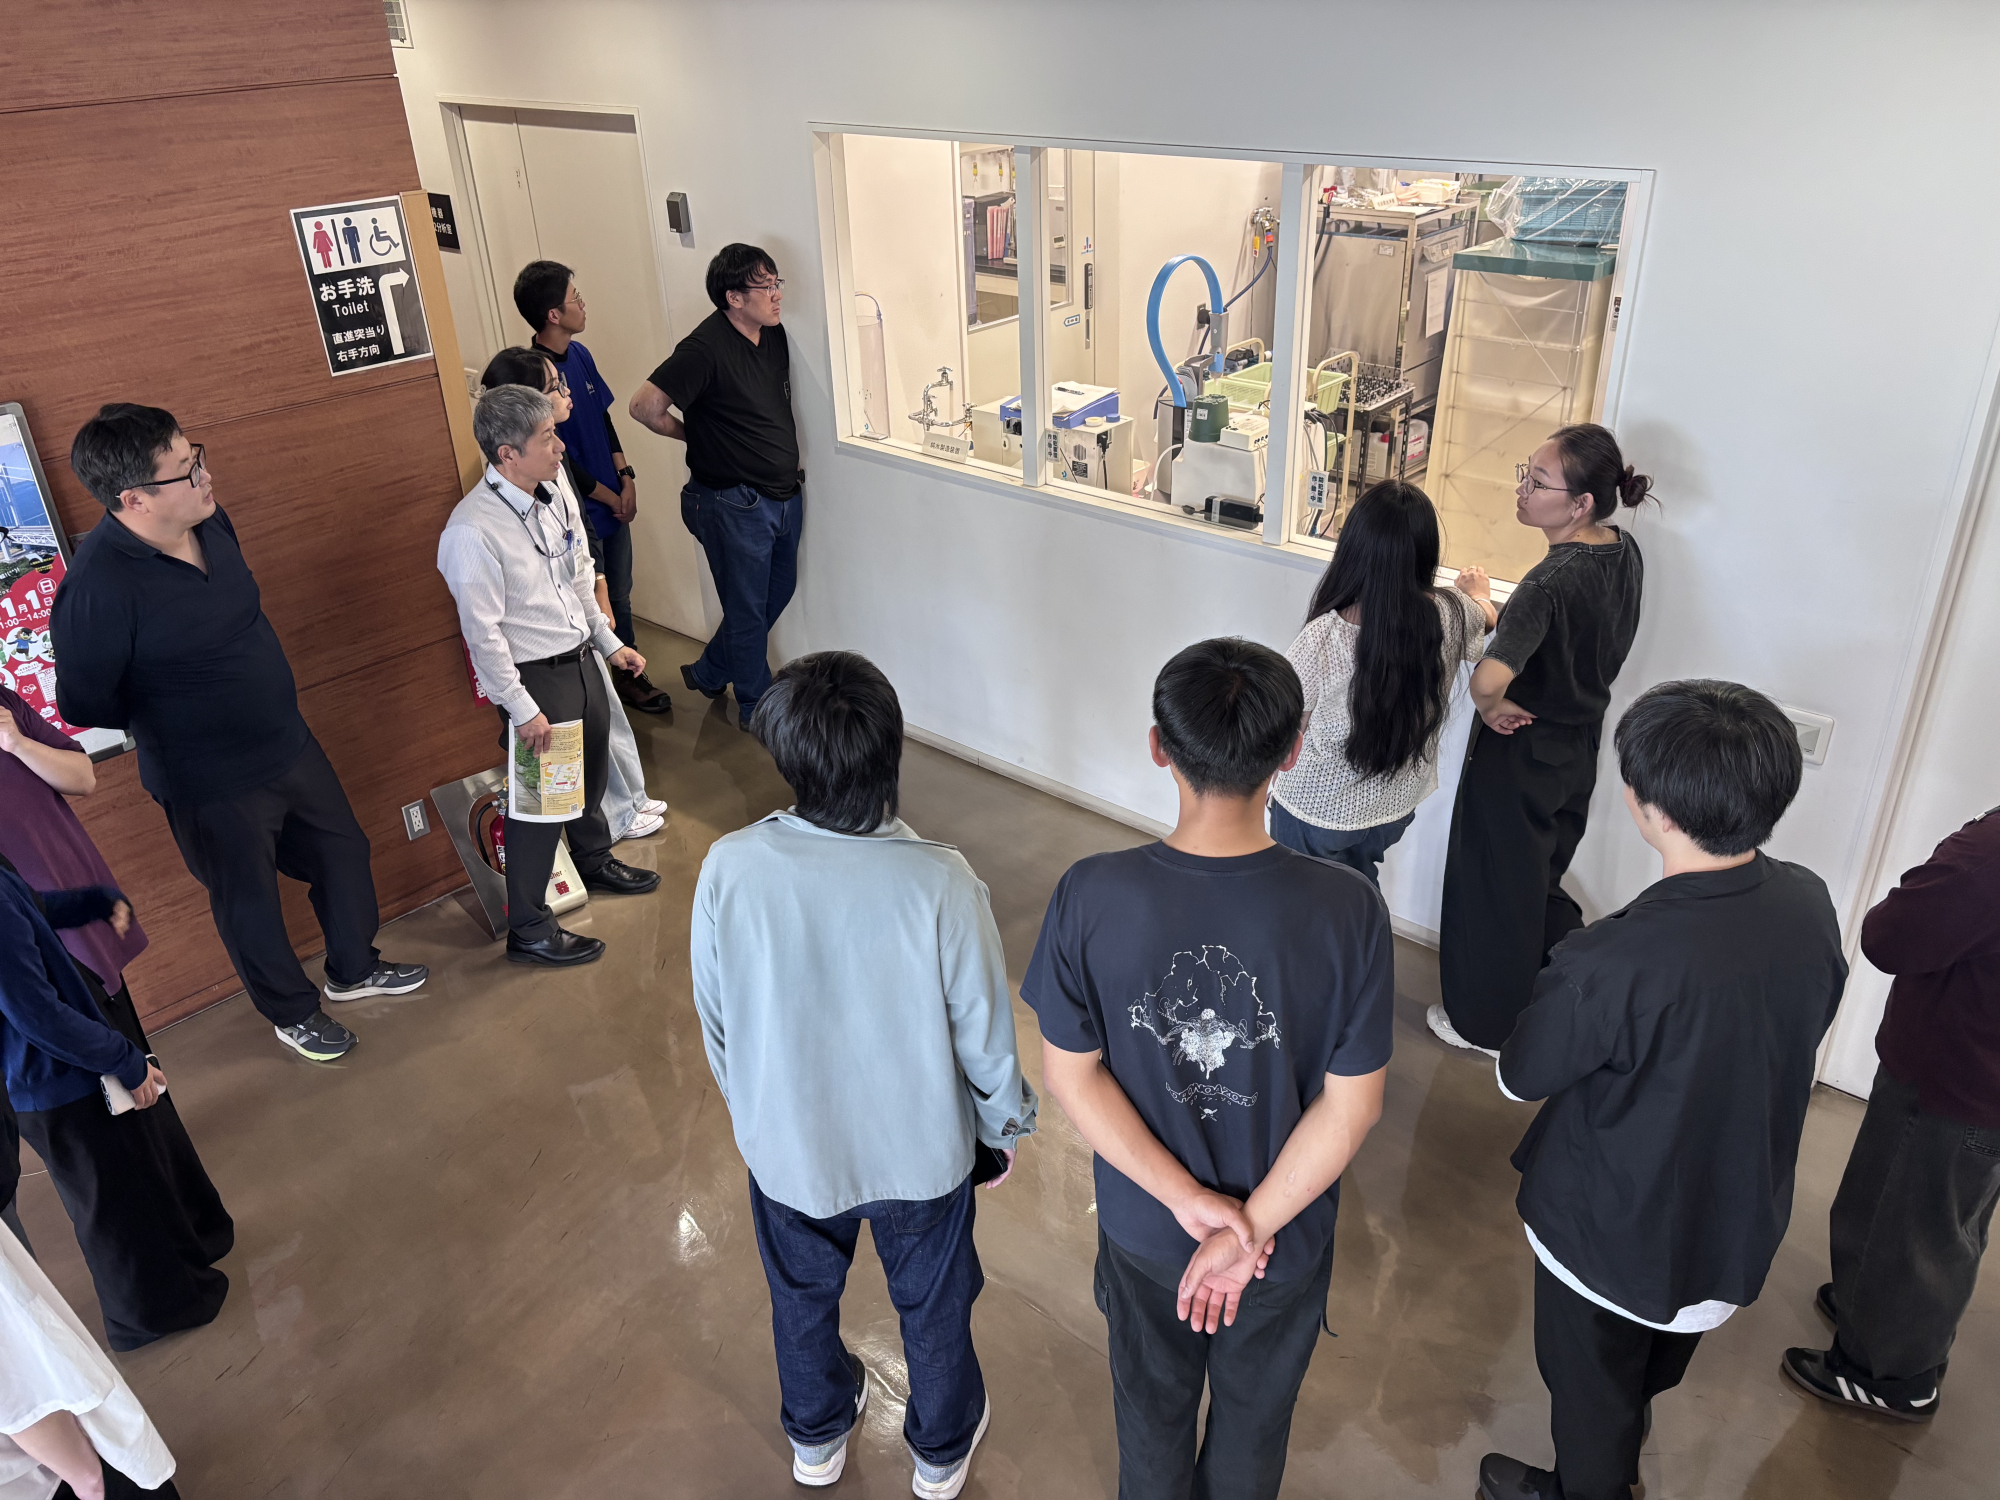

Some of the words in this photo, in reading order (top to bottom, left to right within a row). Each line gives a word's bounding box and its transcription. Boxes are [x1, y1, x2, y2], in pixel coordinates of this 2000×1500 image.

[319, 275, 376, 302] お手洗
[332, 299, 370, 318] Toilet
[331, 323, 386, 345] 直進突当り
[336, 343, 381, 363] 右手方向
